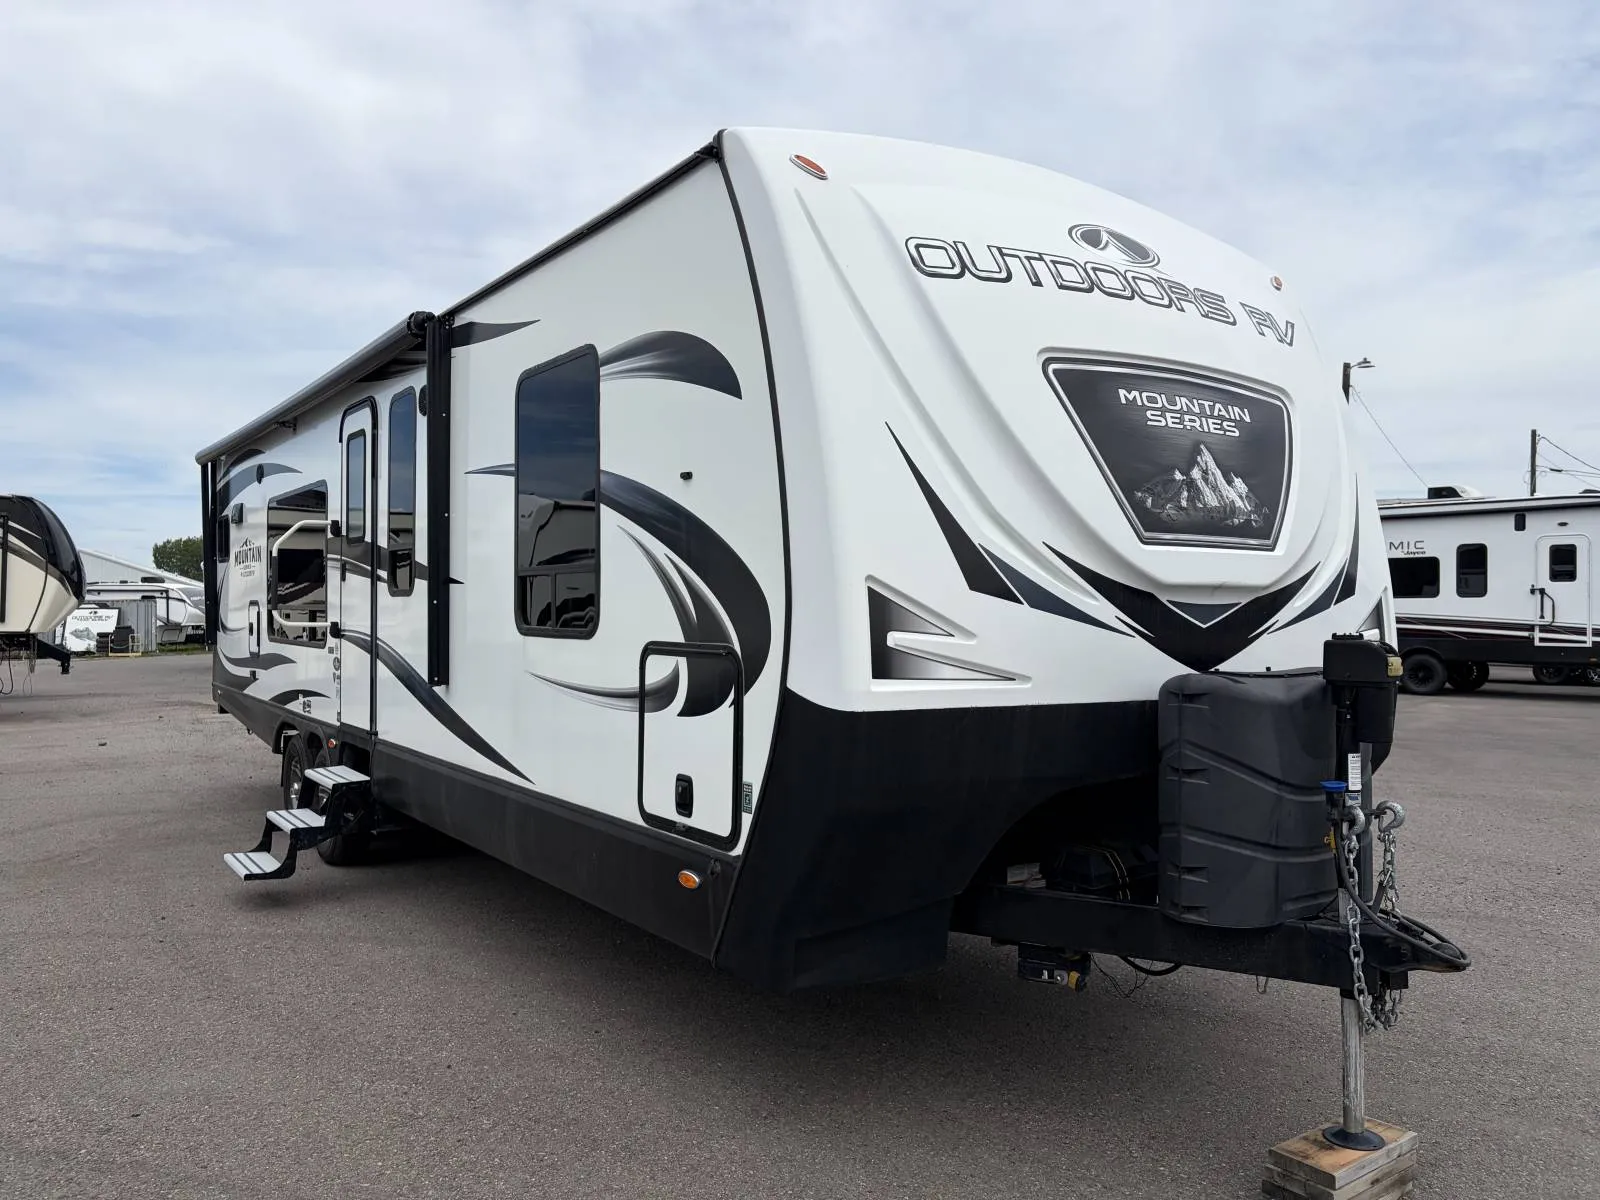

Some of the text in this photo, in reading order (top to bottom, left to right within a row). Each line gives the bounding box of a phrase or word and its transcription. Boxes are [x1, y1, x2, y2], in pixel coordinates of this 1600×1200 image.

[904, 236, 1296, 347] OUTDOORS RV
[1118, 388, 1252, 424] MOUNTAIN
[1147, 409, 1240, 438] SERIES
[234, 545, 262, 567] MOUNTAIN
